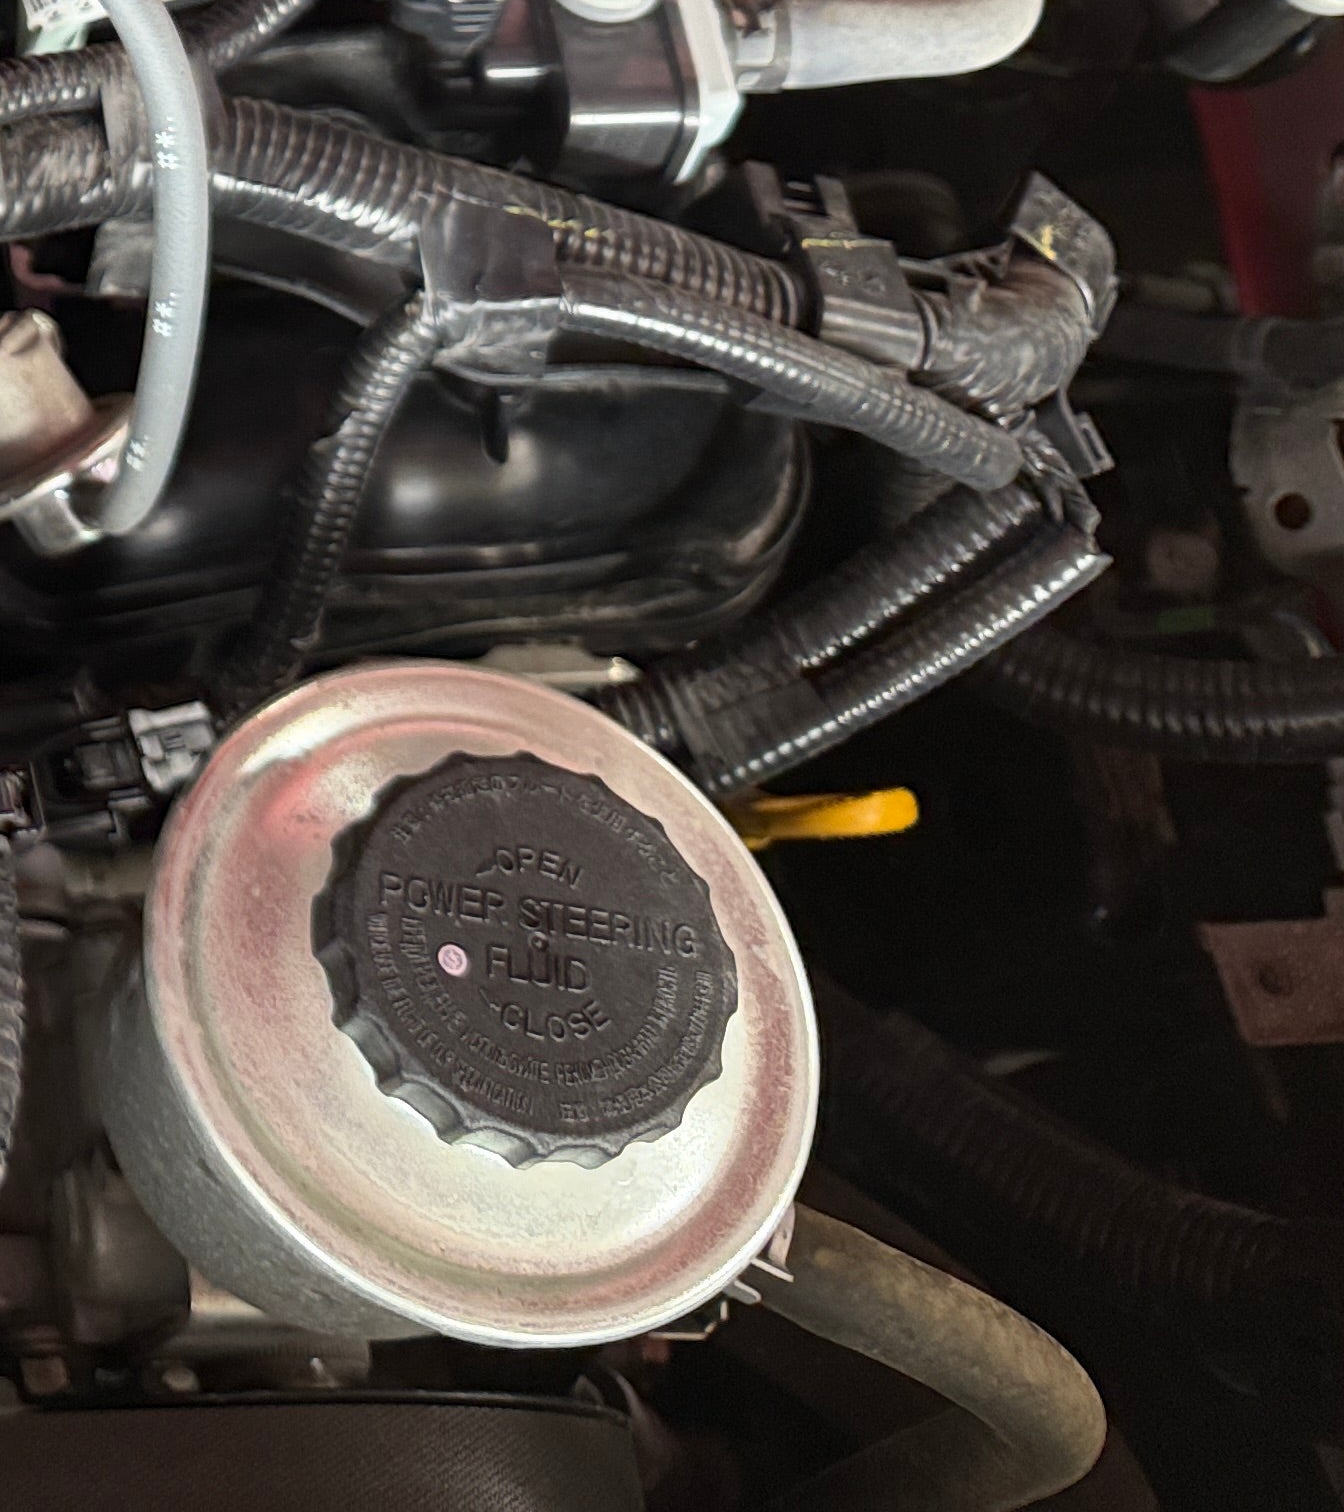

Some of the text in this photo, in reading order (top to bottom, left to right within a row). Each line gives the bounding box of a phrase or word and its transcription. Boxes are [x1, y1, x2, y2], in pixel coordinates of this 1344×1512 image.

[496, 848, 582, 889] OPEN
[380, 872, 699, 958] POWER STEERING
[486, 944, 592, 994] FLUID
[501, 999, 612, 1041] CLOSE
